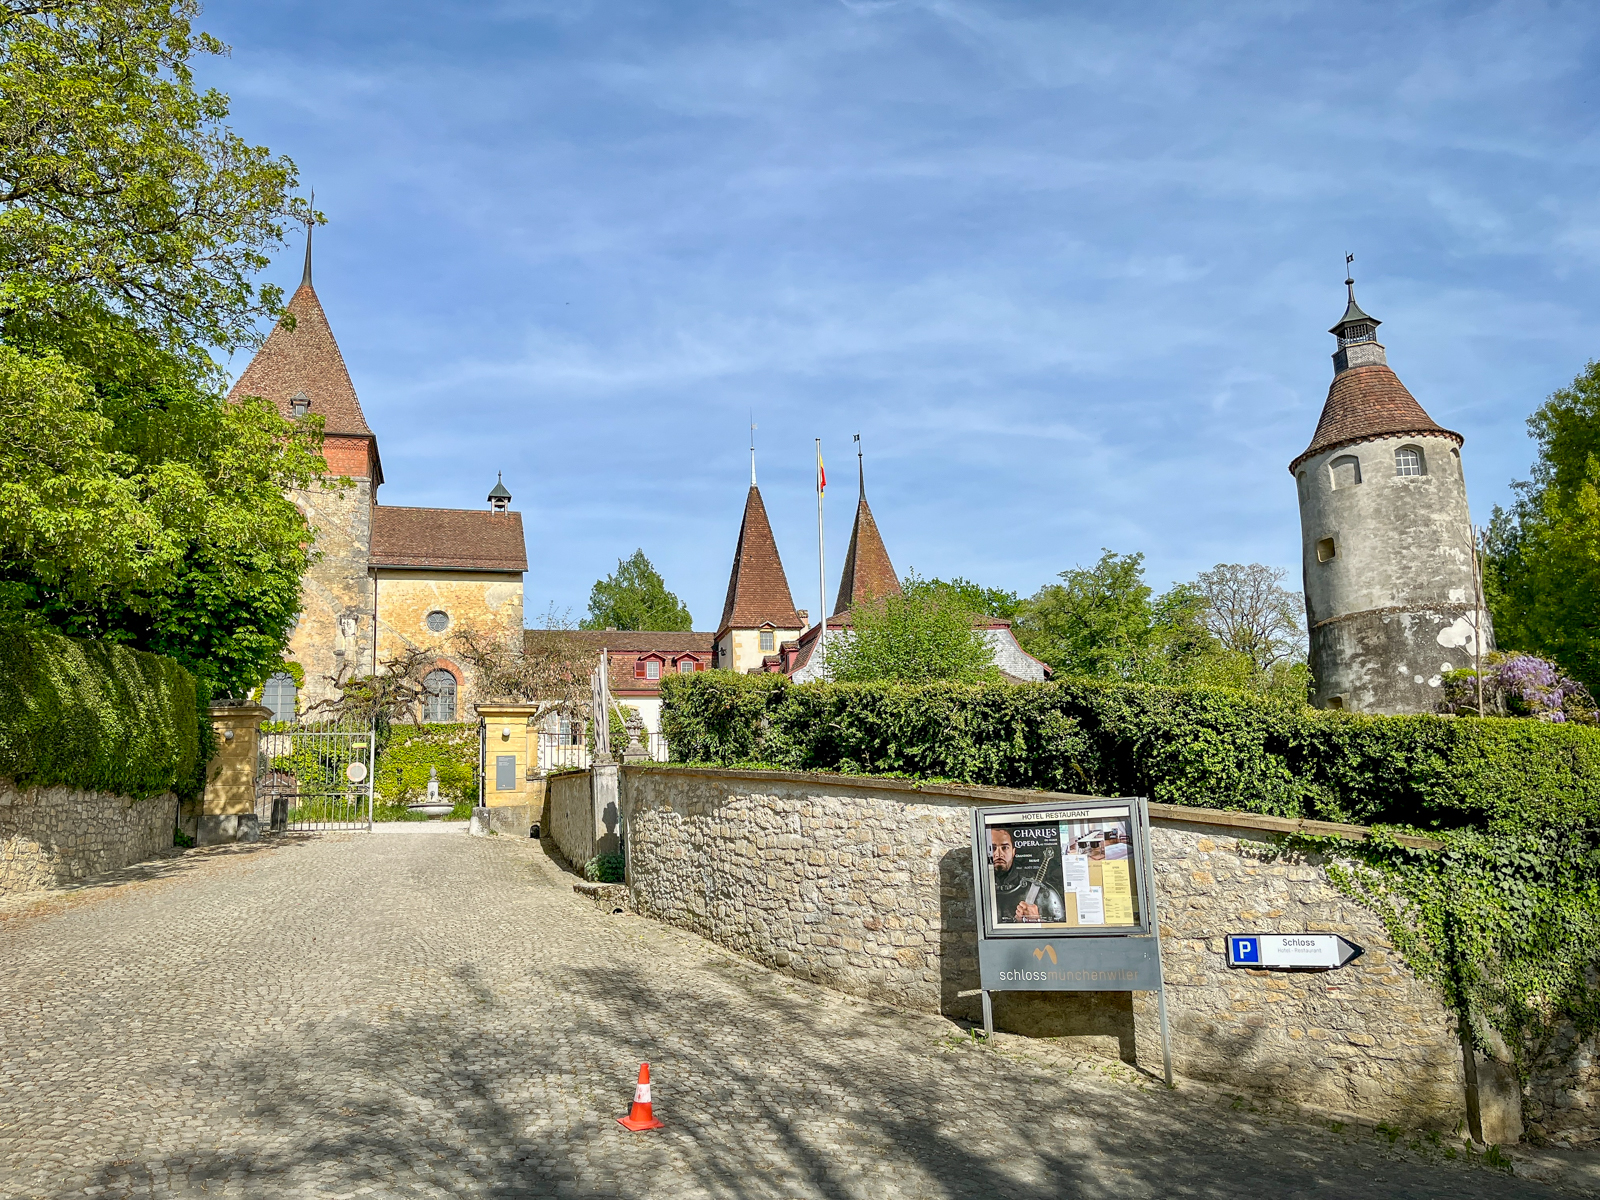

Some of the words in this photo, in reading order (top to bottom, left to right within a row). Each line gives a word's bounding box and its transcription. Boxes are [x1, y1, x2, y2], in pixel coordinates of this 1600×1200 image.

[1046, 810, 1090, 819] RESTAURANT
[1013, 828, 1057, 839] CHARLES
[1282, 938, 1316, 947] Schloss
[1239, 941, 1251, 959] P
